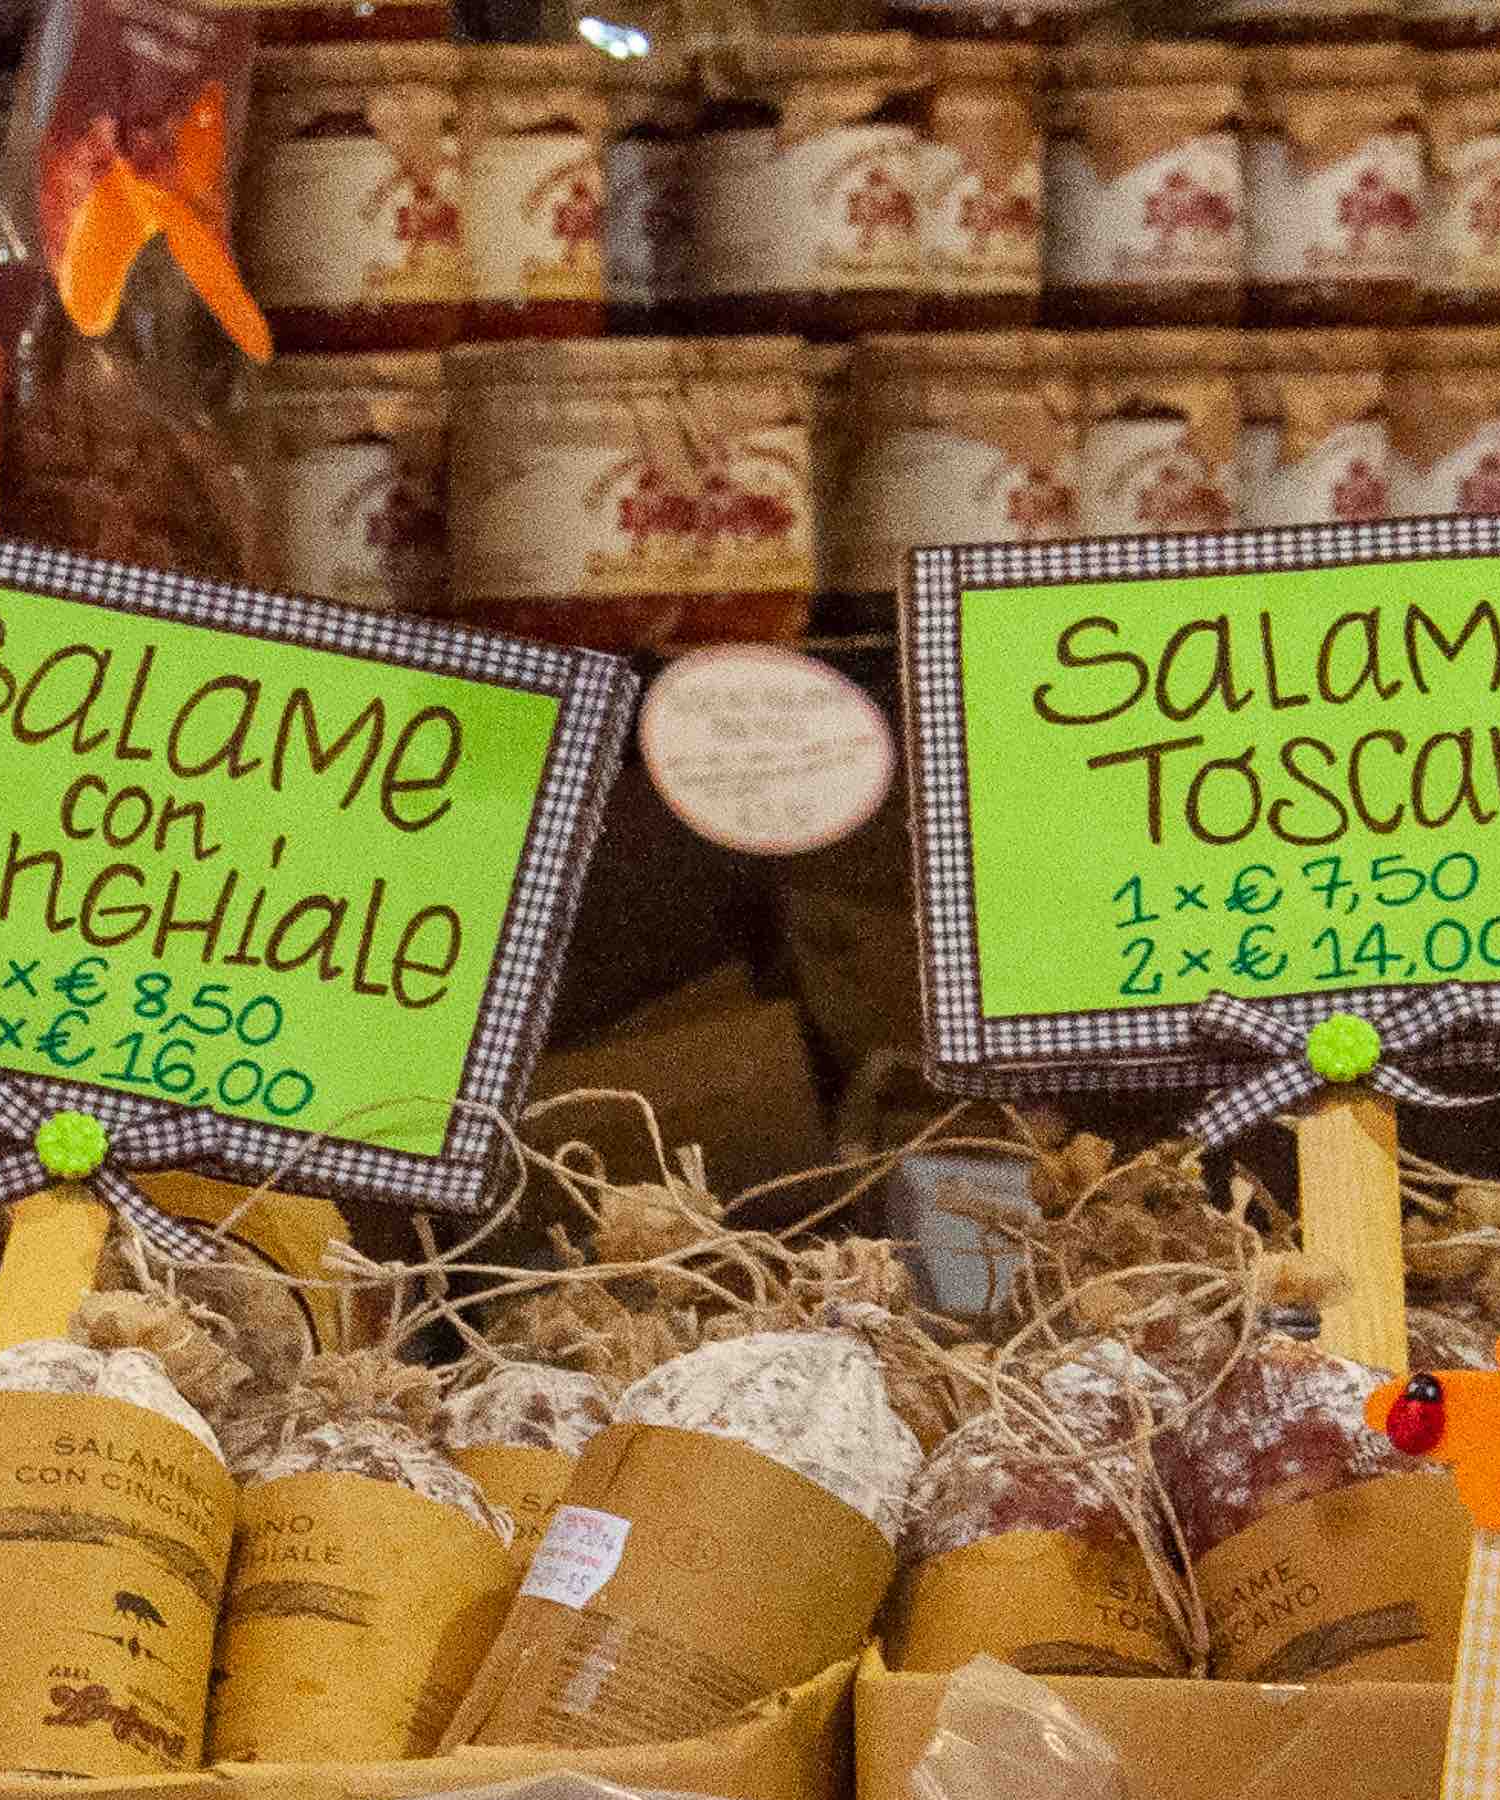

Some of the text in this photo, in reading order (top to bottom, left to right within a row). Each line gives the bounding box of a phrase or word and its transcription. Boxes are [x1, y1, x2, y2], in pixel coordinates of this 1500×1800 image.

[62, 773, 220, 859] con
[1113, 875, 1149, 929] 1
[1225, 863, 1282, 915] €
[1303, 851, 1480, 914] 7,50
[1119, 937, 1163, 996] 2
[1229, 923, 1288, 981] €
[55, 955, 110, 1008] €
[134, 970, 284, 1047] 8,50
[37, 1010, 93, 1068] €
[102, 1031, 315, 1119] 16,00
[15, 1465, 87, 1485] CON
